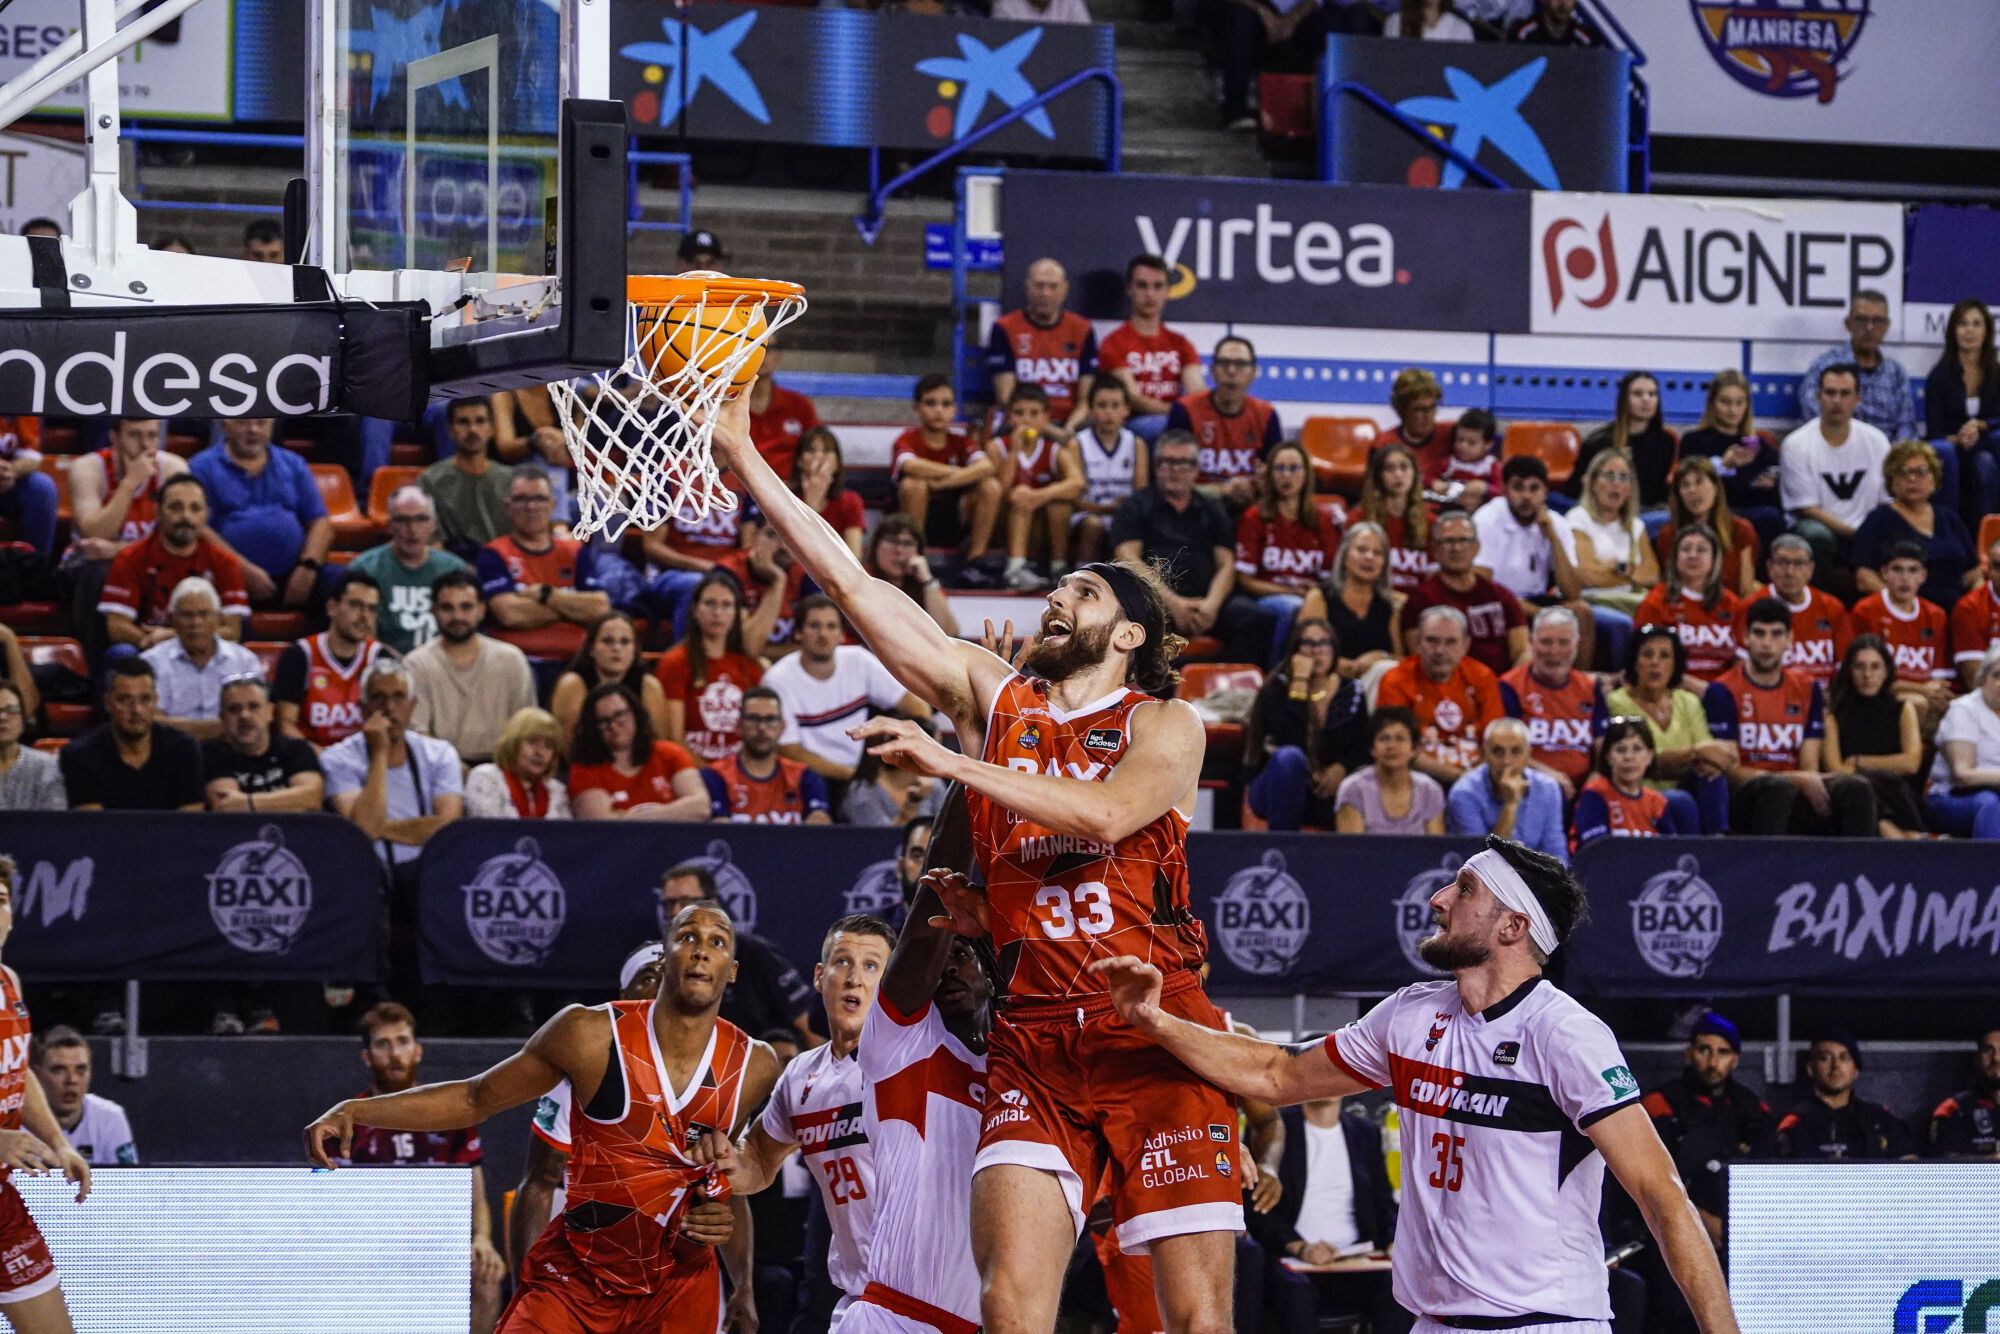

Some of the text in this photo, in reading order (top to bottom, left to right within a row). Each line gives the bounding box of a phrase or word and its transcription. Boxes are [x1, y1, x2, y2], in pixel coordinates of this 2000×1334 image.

[1726, 16, 1838, 51] MANRESA
[1626, 227, 1895, 308] AIGNEP
[1016, 358, 1079, 382] BAXI
[1199, 447, 1255, 475] BAX
[1262, 546, 1325, 573] BAXI
[1679, 622, 1734, 648] BAX
[310, 701, 364, 727] BAX
[1528, 718, 1592, 745] BAX
[1744, 723, 1803, 751] BAXI
[215, 877, 306, 907] BAXI
[471, 889, 560, 921] BAXI
[1035, 881, 1116, 940] 33
[1222, 901, 1304, 930] BAXI
[1638, 904, 1718, 932] BAXI
[1410, 1076, 1509, 1118] COVIRAN
[796, 1111, 863, 1147] COVIRA
[1143, 1125, 1204, 1152] Adbisio
[1211, 1131, 1225, 1140] acb
[391, 1133, 416, 1158] 15
[1141, 1150, 1178, 1172] ETL
[1429, 1132, 1466, 1193] 35
[823, 1156, 868, 1206] 29
[1143, 1165, 1210, 1189] GLOBAL
[5, 1254, 35, 1275] ETL
